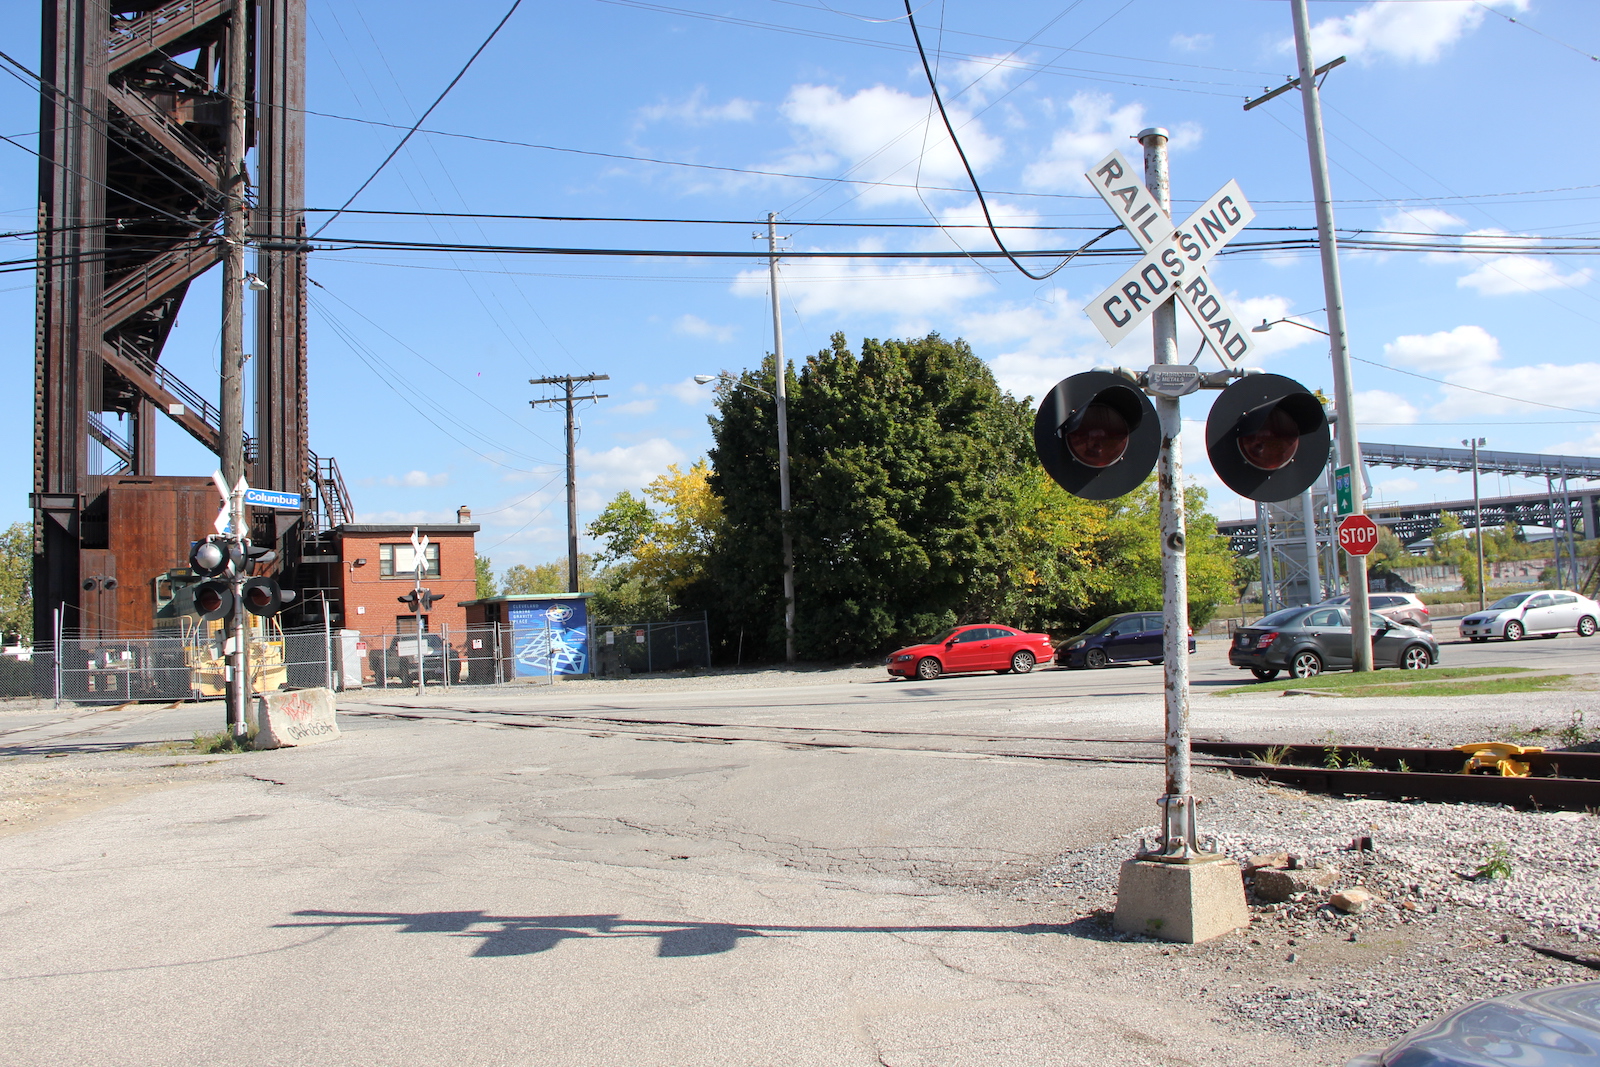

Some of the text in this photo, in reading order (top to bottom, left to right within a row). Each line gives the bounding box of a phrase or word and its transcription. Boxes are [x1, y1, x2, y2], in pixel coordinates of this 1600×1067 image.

[1097, 157, 1247, 361] RAIL ROAD
[1103, 195, 1242, 328] CROSSING
[247, 491, 298, 506] Columbus
[1341, 527, 1375, 544] STOP
